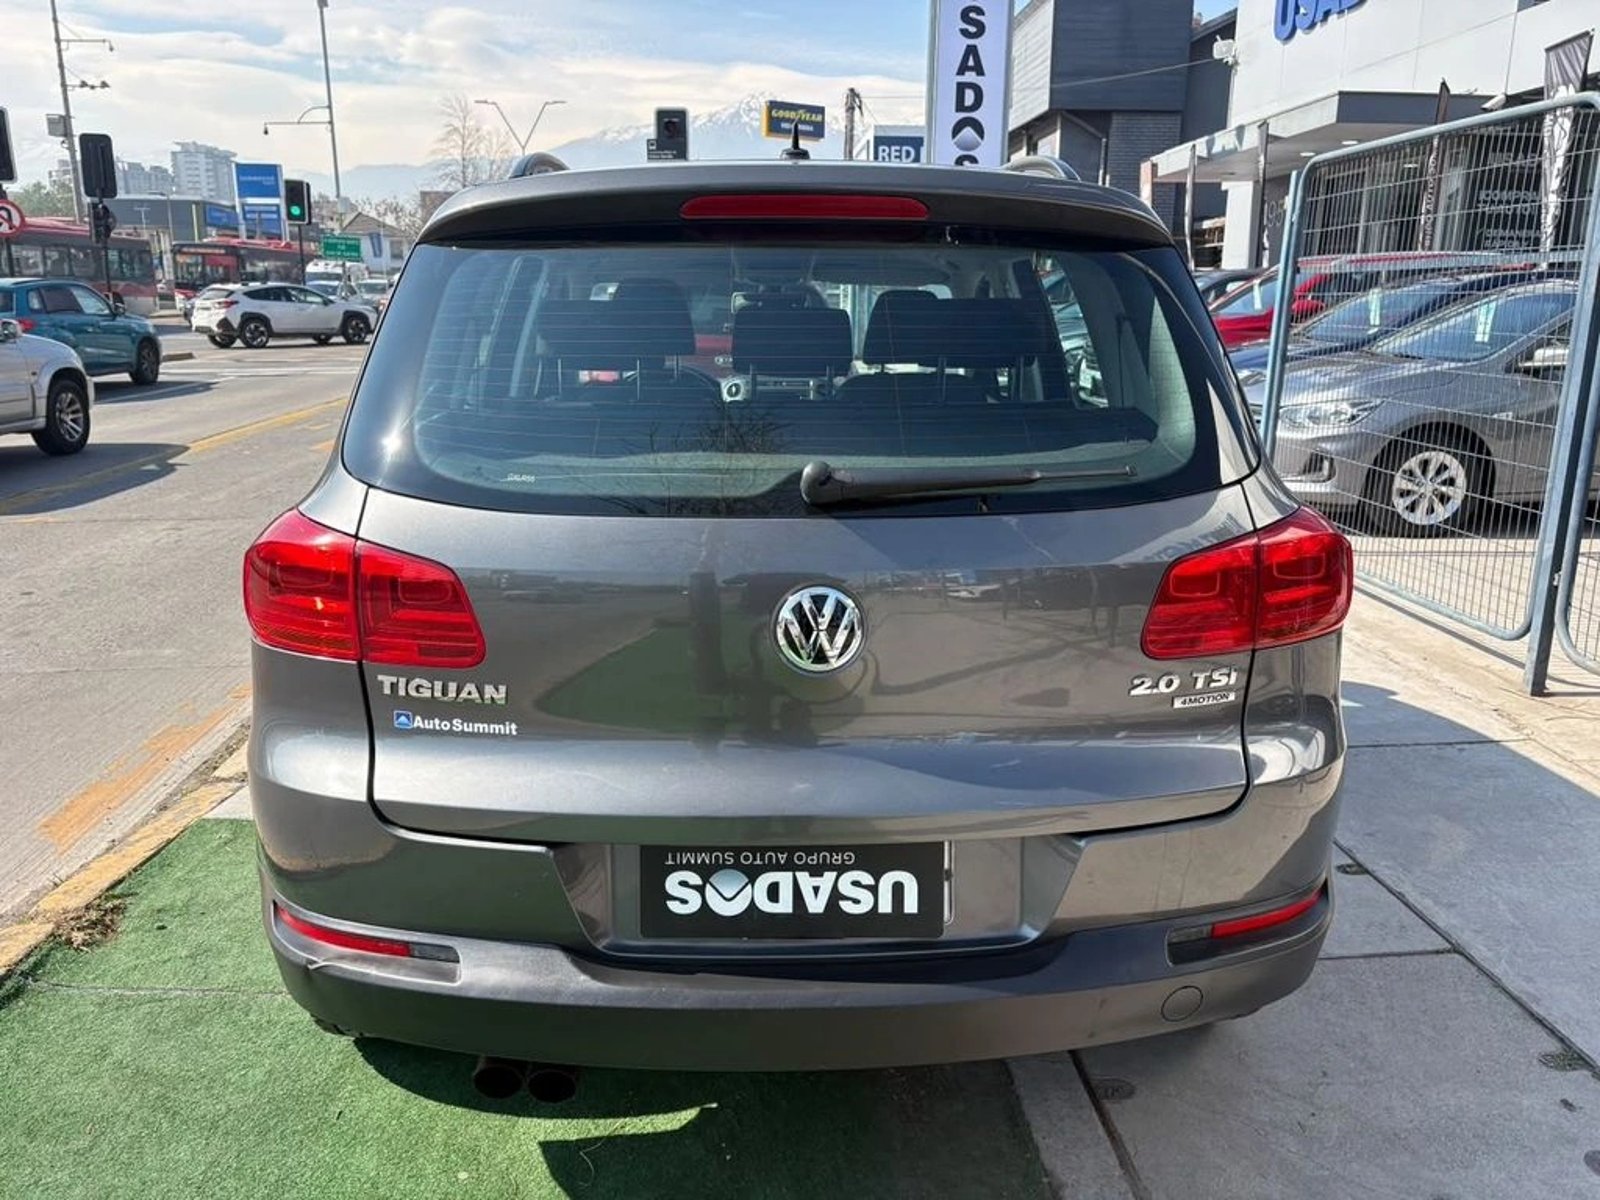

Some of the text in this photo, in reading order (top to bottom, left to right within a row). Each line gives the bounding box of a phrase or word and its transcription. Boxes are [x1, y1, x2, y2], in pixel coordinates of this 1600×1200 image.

[951, 0, 986, 166] SADO
[771, 109, 823, 122] GOODYEAR
[878, 145, 915, 162] RED
[376, 674, 507, 705] TIGUAN
[1128, 674, 1180, 696] 2.0
[1180, 692, 1230, 706] 4MOTION
[665, 851, 855, 865] GRUPO AUTO SUMMIT
[664, 868, 919, 917] USADOS
